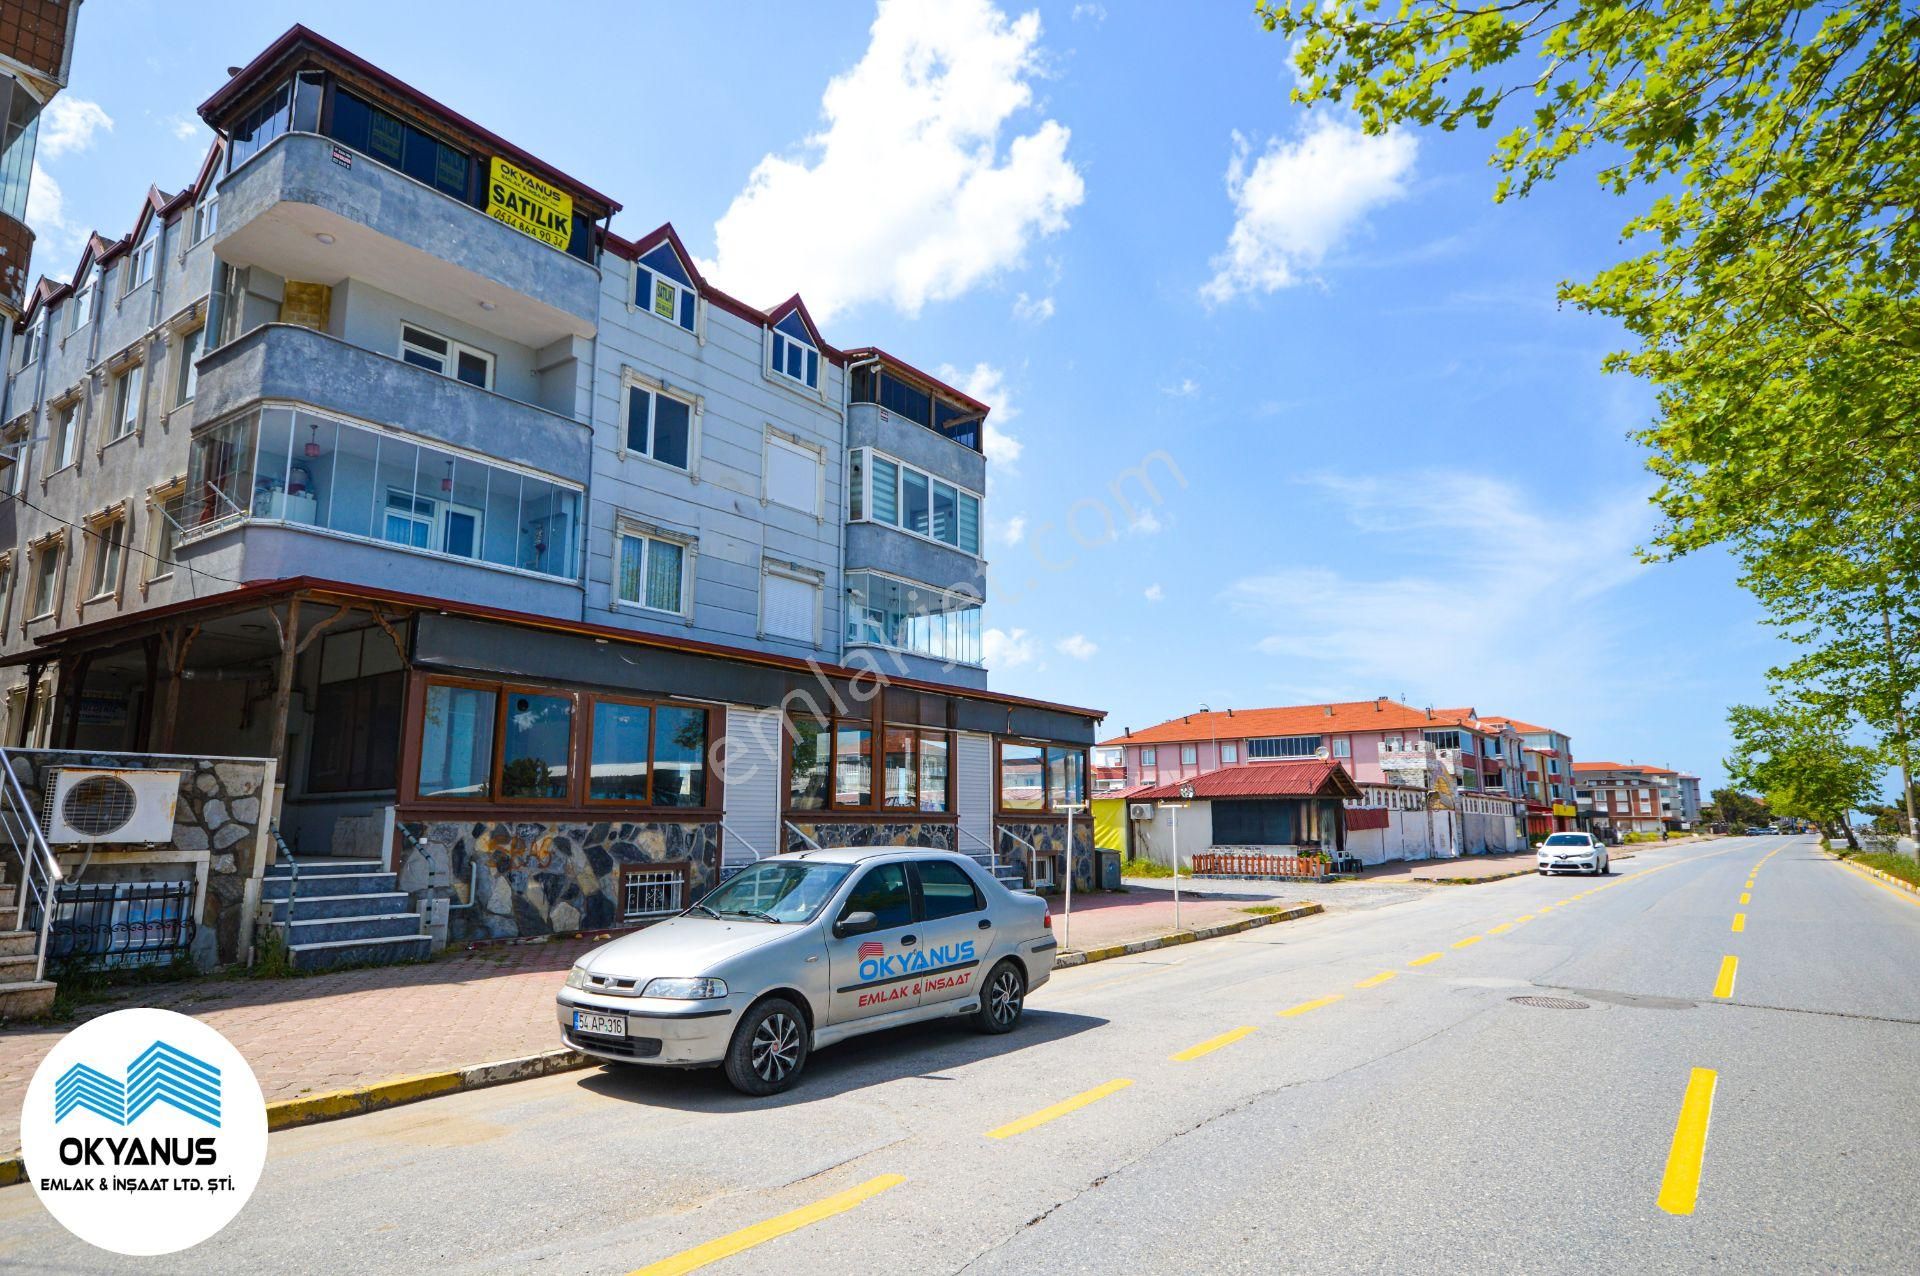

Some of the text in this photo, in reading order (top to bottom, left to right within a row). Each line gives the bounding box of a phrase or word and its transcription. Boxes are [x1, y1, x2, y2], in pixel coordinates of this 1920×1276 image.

[500, 164, 561, 202] OKYANUS
[493, 183, 568, 237] SATILIK
[494, 208, 563, 248] 0534 864 90 34
[859, 940, 975, 981] OKYANUS
[858, 972, 972, 1008] EMLAK & İNŞAAT
[579, 1014, 623, 1034] 54 AP 316
